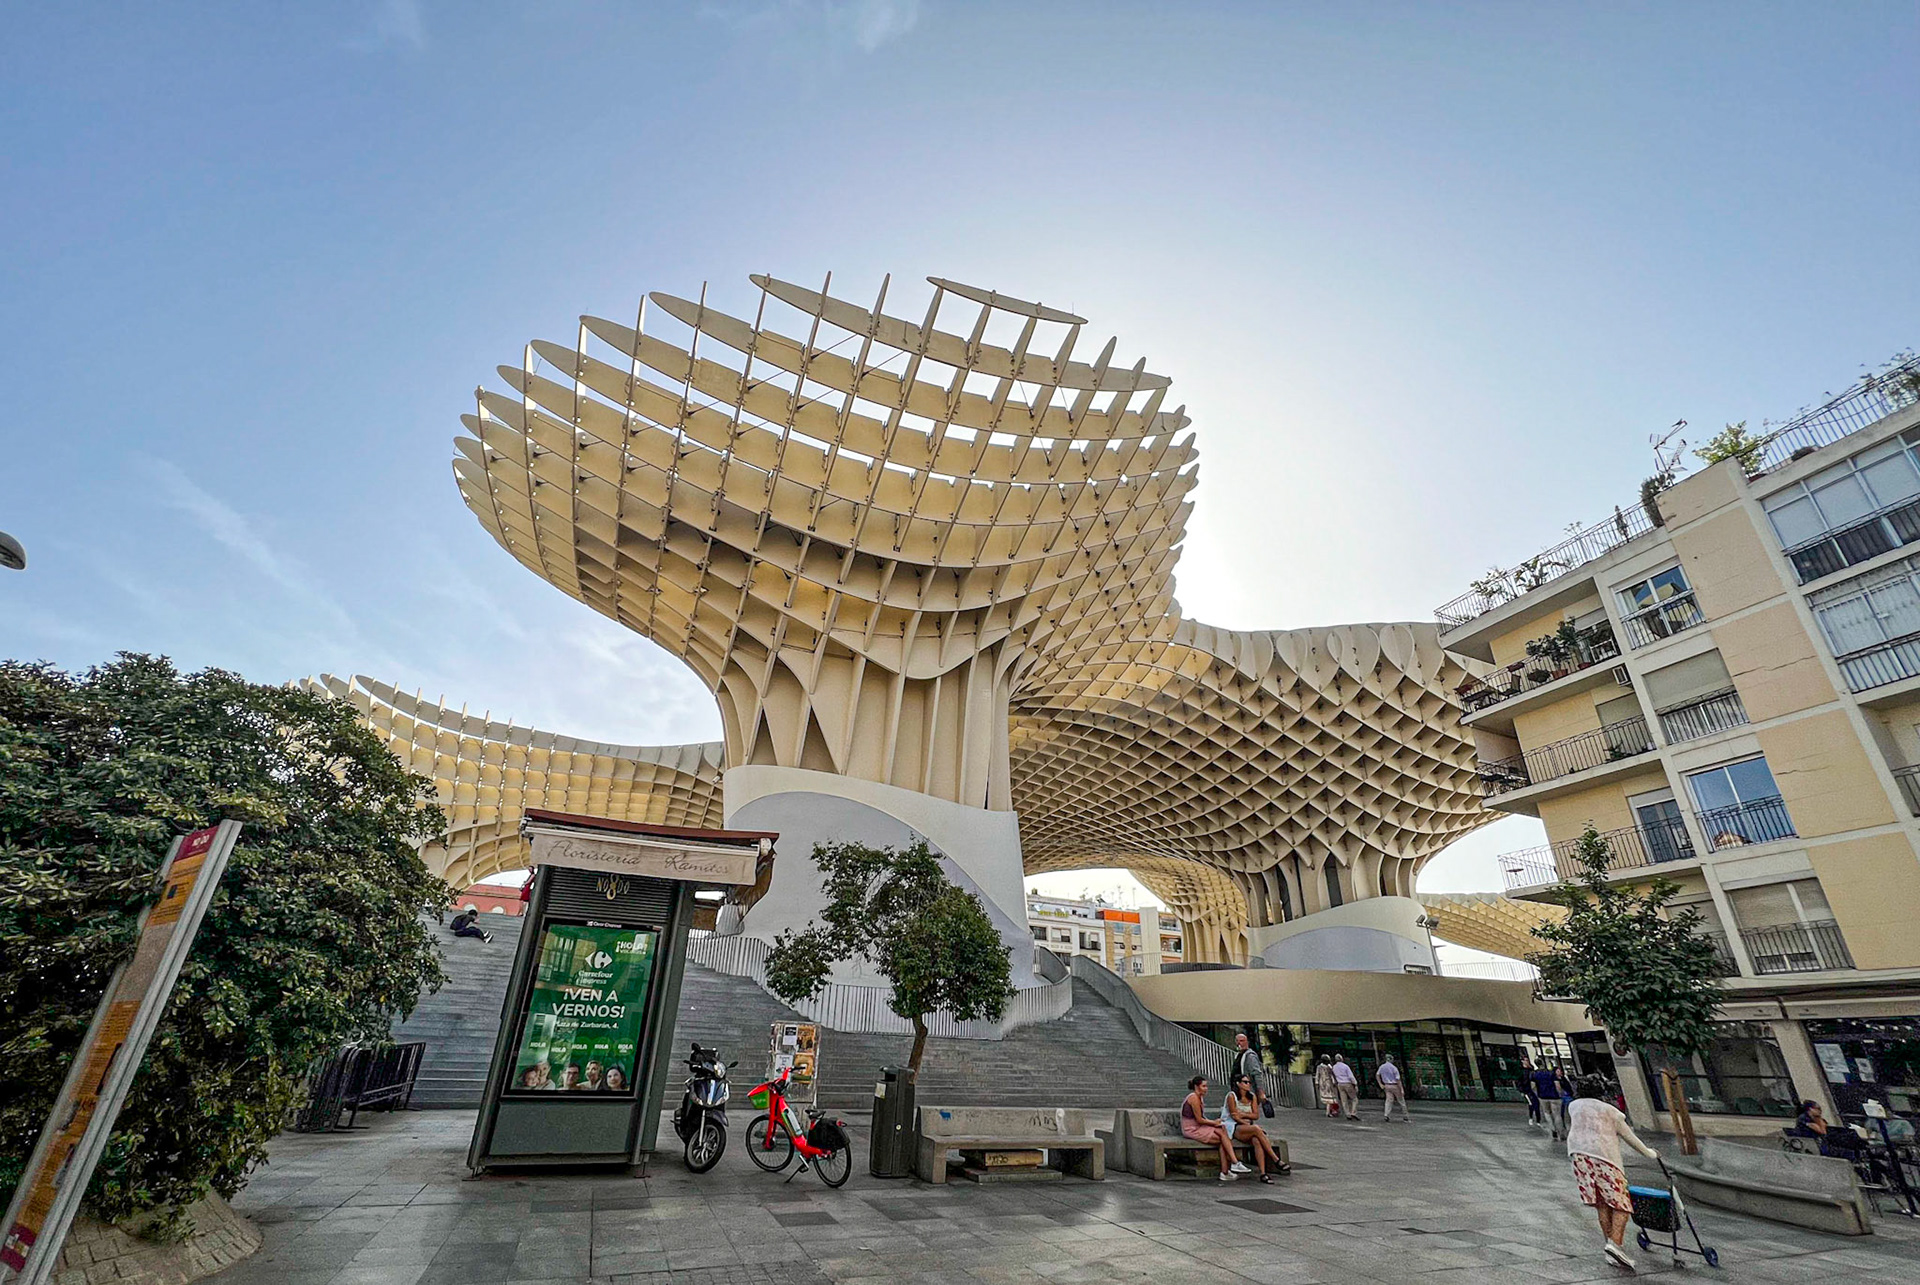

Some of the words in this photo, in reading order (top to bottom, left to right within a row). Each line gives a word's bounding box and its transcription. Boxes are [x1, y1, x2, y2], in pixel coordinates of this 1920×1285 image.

[578, 970, 613, 978] Carrefour
[563, 988, 602, 1001] ¡VEN
[605, 990, 618, 1002] A
[552, 1003, 625, 1018] VERNOS!
